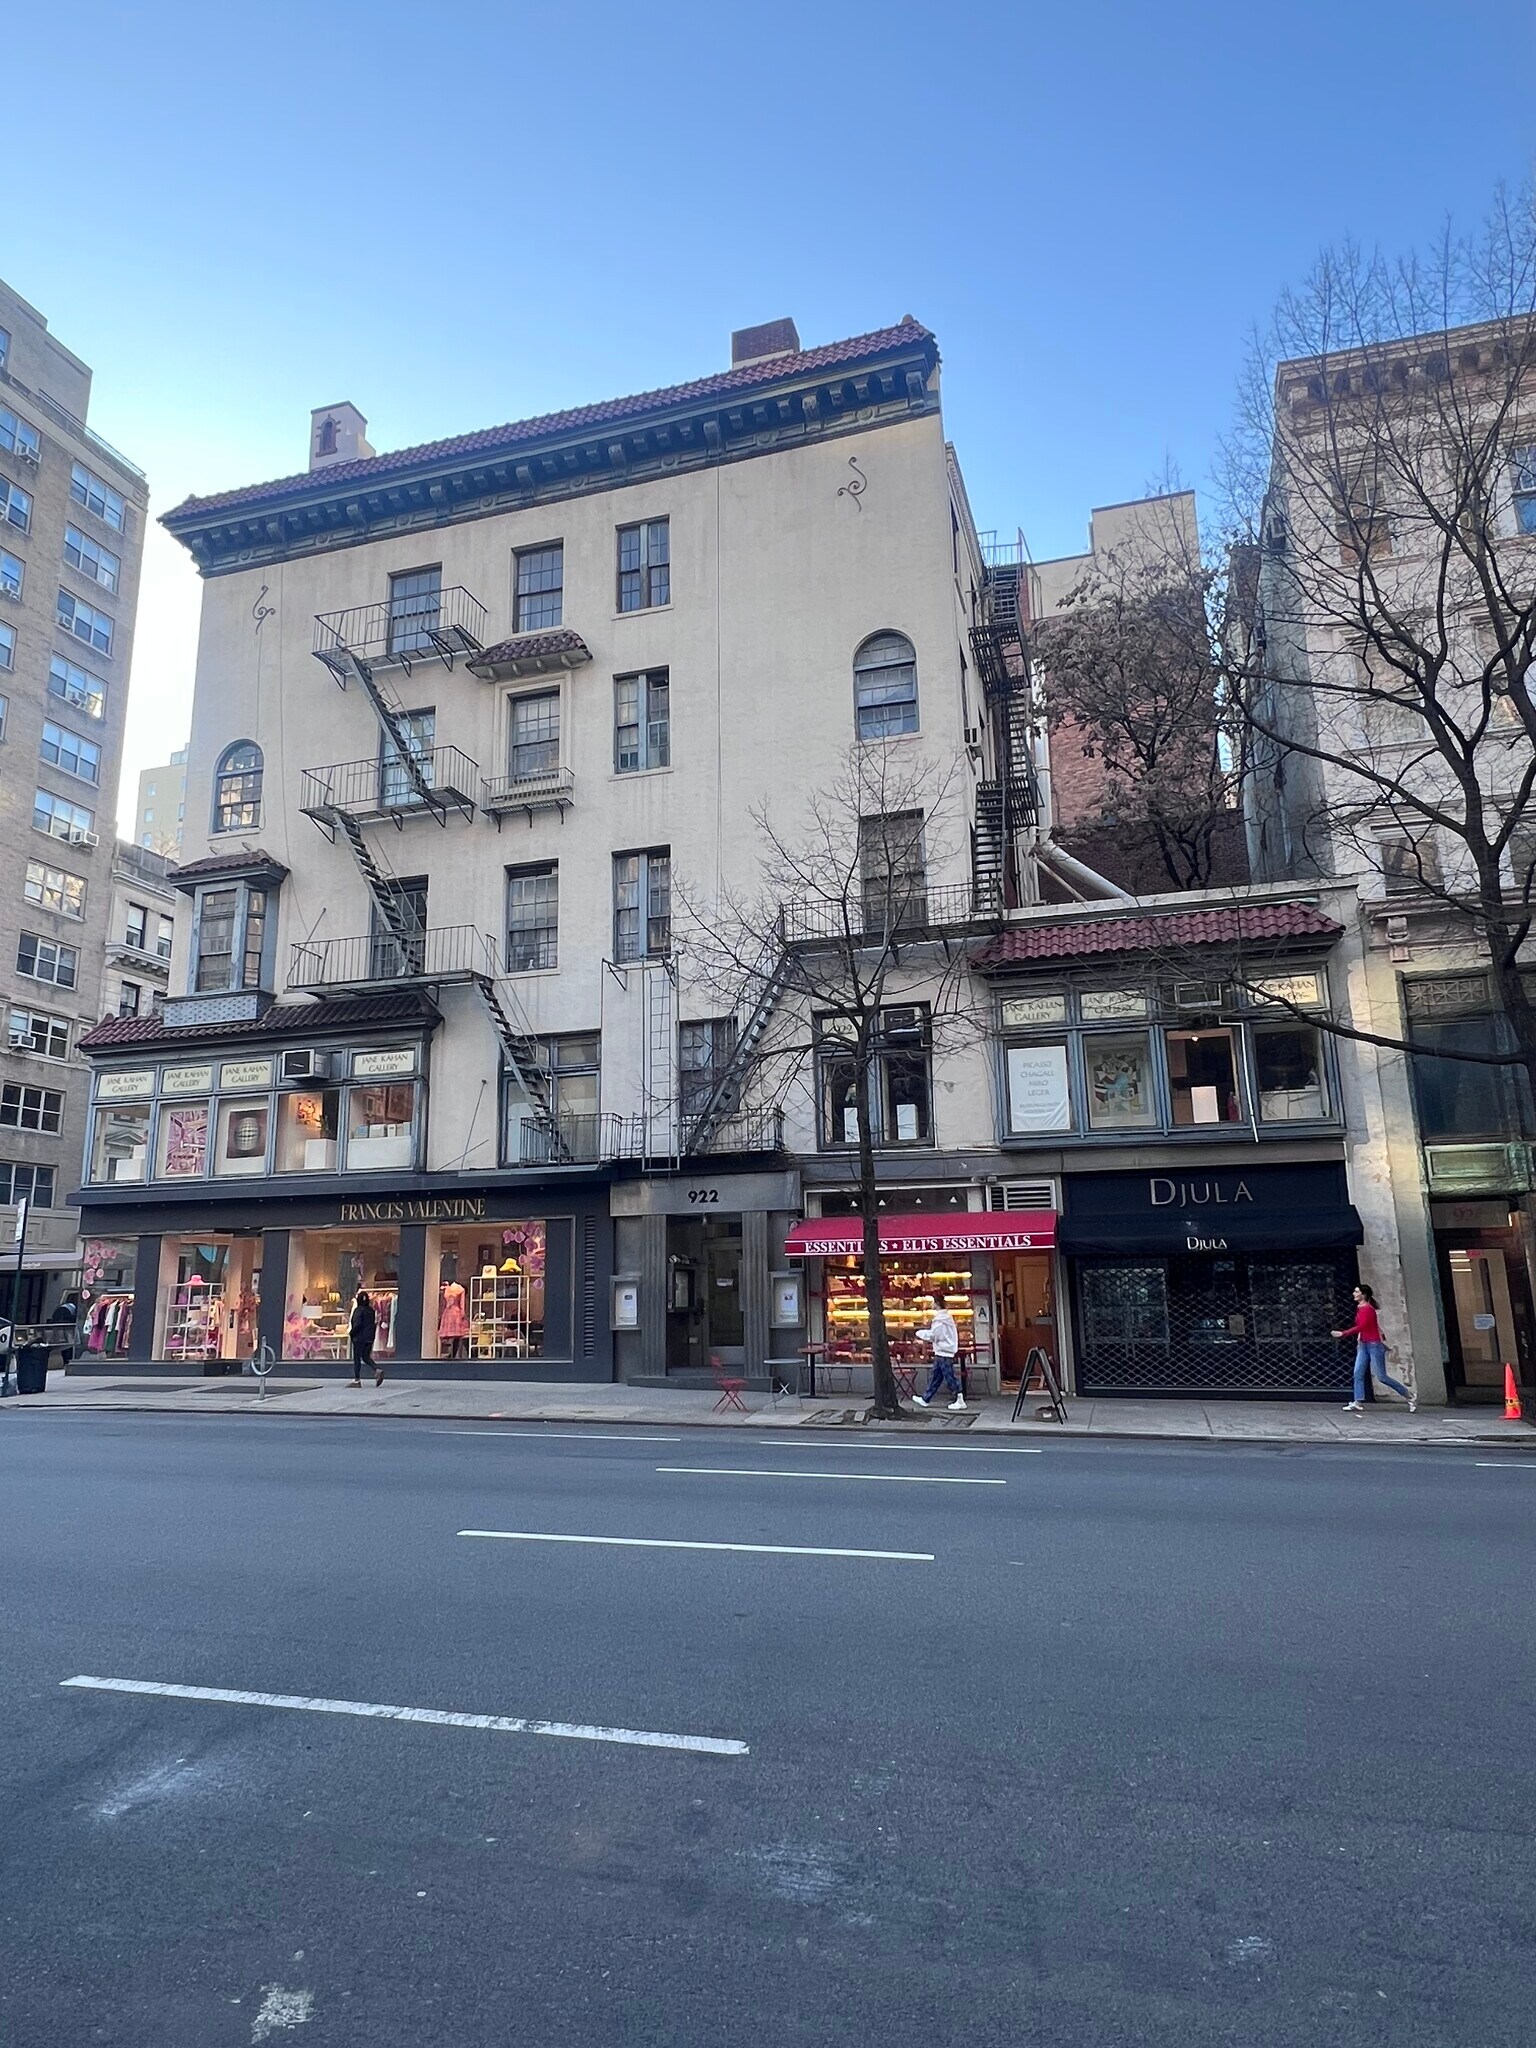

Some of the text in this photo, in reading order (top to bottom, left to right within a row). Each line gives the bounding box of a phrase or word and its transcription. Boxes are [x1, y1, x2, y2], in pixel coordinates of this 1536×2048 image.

[1015, 1011, 1050, 1021] GALLERY
[361, 1053, 408, 1064] JANE KAHAN
[225, 1065, 268, 1075] JANE KAHAN
[369, 1063, 399, 1072] GALLERY
[107, 1075, 147, 1085] JANE KAHAN
[167, 1072, 181, 1080] JANE
[231, 1074, 259, 1083] GALLERY
[112, 1084, 139, 1093] GALLERY
[173, 1079, 200, 1088] GALLERY
[688, 1189, 719, 1203] 922
[1150, 1178, 1253, 1208] DJULA
[341, 1198, 486, 1221] FRANCES VALENTINE
[805, 1235, 1031, 1253] ESSENTIS ELI'S ESSENTIALS
[1186, 1236, 1228, 1250] DJULA
[978, 1306, 987, 1317] A
